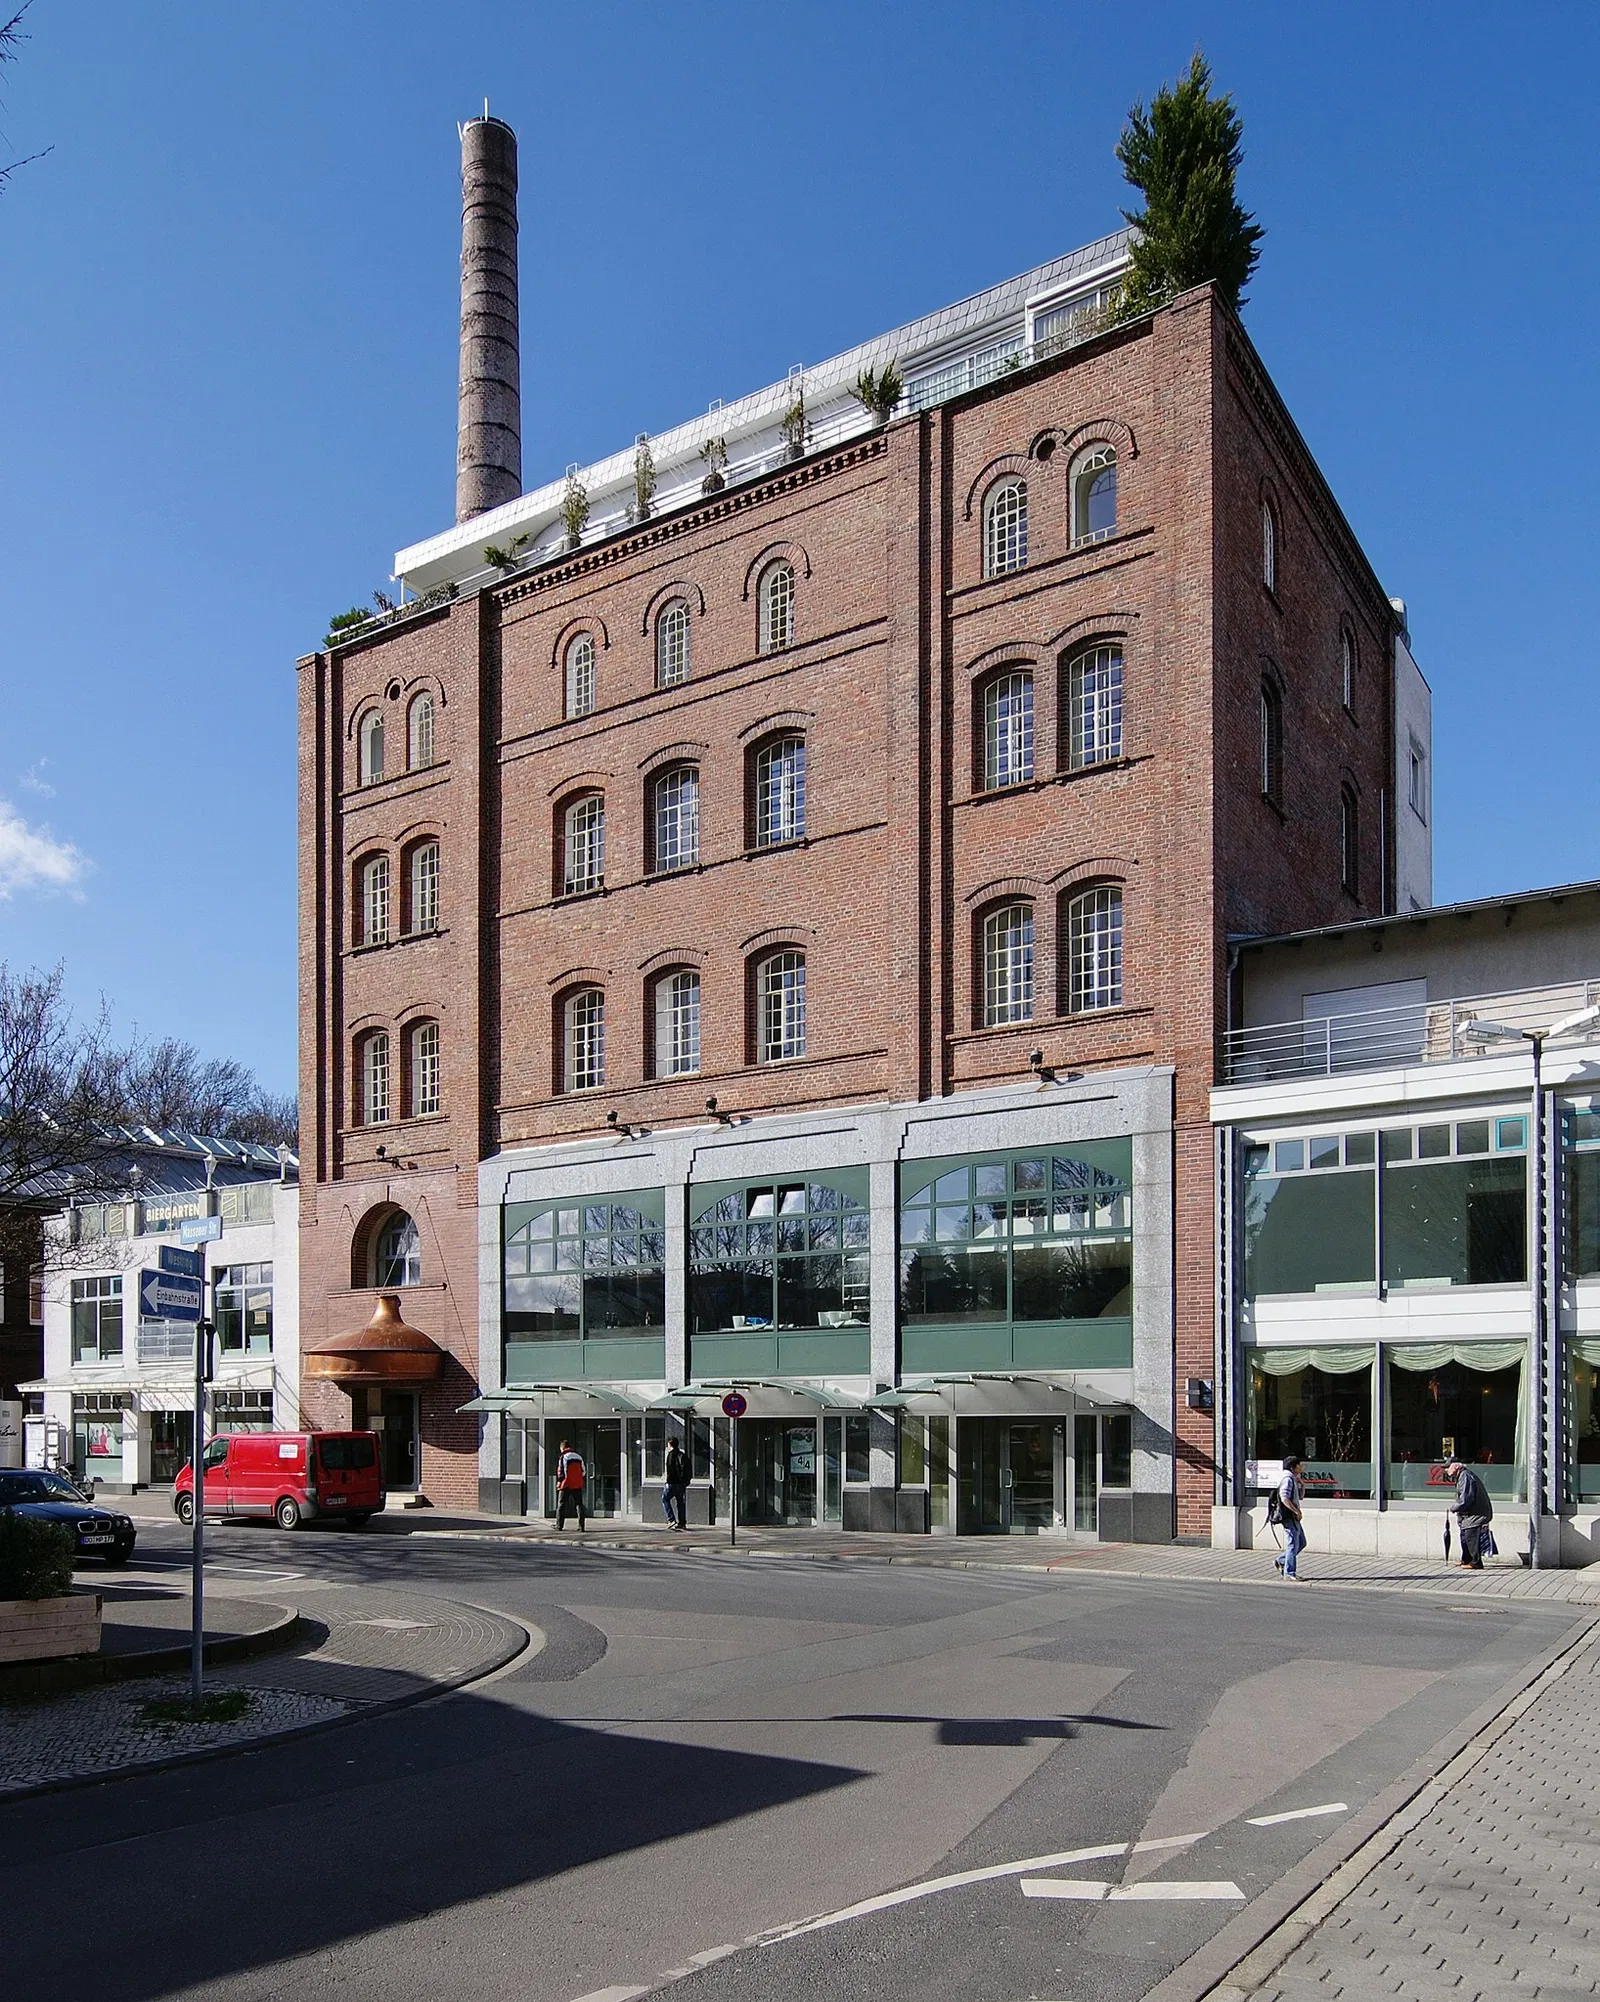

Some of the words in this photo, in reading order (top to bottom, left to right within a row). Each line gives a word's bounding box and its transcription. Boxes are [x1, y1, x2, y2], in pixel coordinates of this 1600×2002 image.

[146, 1204, 199, 1222] BIERGARTEN
[157, 1289, 198, 1305] Einbahnstraße
[1300, 1470, 1335, 1482] REMA
